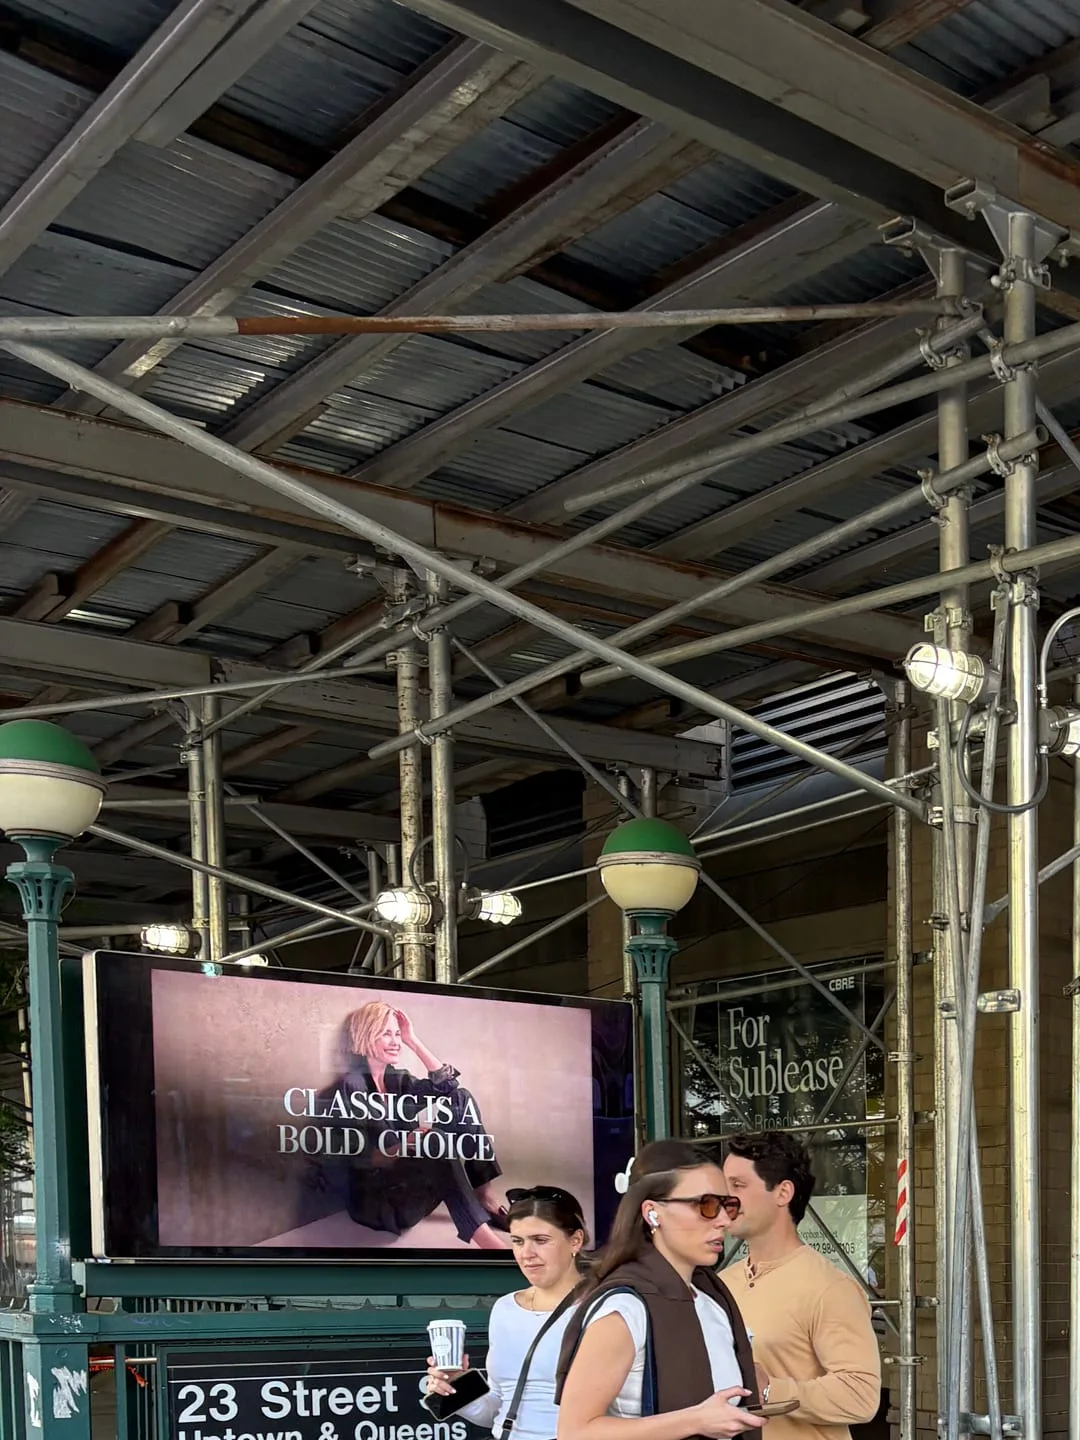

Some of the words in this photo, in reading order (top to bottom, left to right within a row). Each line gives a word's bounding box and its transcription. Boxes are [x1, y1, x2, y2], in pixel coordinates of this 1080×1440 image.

[828, 976, 855, 991] CBRE
[727, 1007, 770, 1050] For
[729, 1048, 844, 1100] Sublease
[283, 1087, 419, 1123] CLASSIC
[423, 1095, 453, 1125] IS
[459, 1096, 482, 1126] A
[277, 1124, 366, 1156] BOLD
[378, 1129, 496, 1162] CHOICE
[177, 1383, 239, 1424] 23
[260, 1377, 398, 1420] Street
